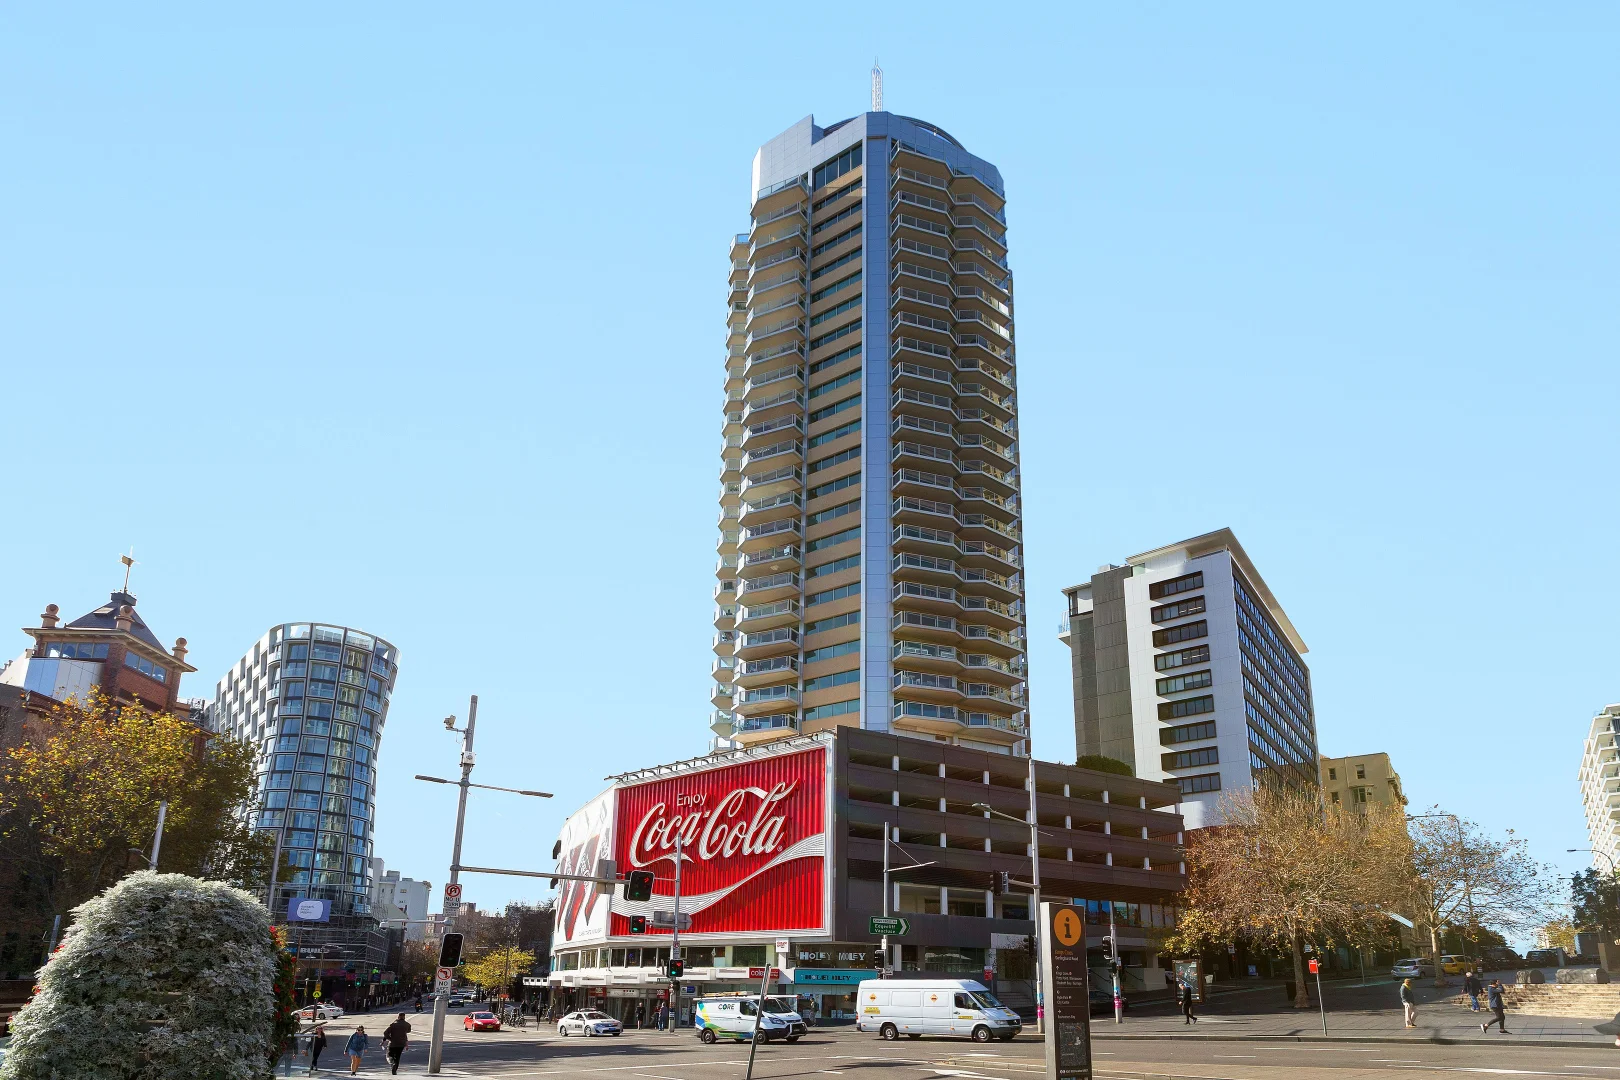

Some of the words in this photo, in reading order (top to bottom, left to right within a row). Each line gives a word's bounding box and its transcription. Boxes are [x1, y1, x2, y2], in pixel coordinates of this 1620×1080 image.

[677, 792, 707, 807] Enjoy
[629, 778, 801, 868] Coca-Cola
[799, 951, 832, 961] HOLEY
[838, 952, 867, 961] MOLEY
[717, 1003, 736, 1011] CORE
